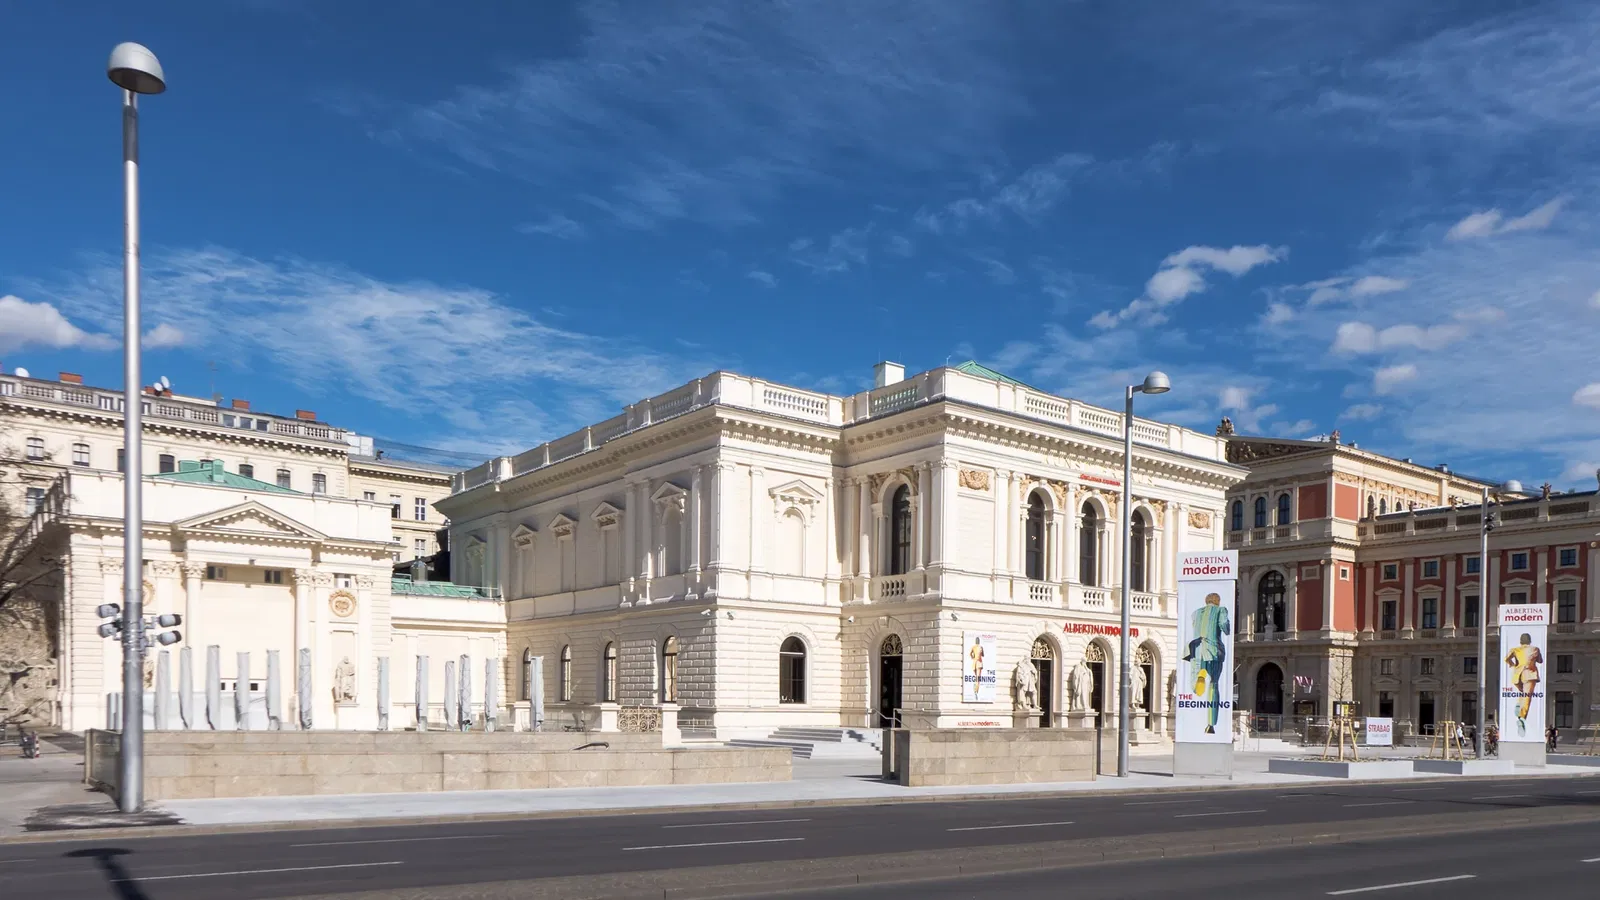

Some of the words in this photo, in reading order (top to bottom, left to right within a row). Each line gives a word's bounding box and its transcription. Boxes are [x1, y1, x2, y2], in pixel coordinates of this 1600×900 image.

[1183, 556, 1230, 565] ALBERTINA
[1182, 564, 1230, 575] modern
[1178, 700, 1230, 709] BEGINNING
[1368, 724, 1390, 733] STRABAG
